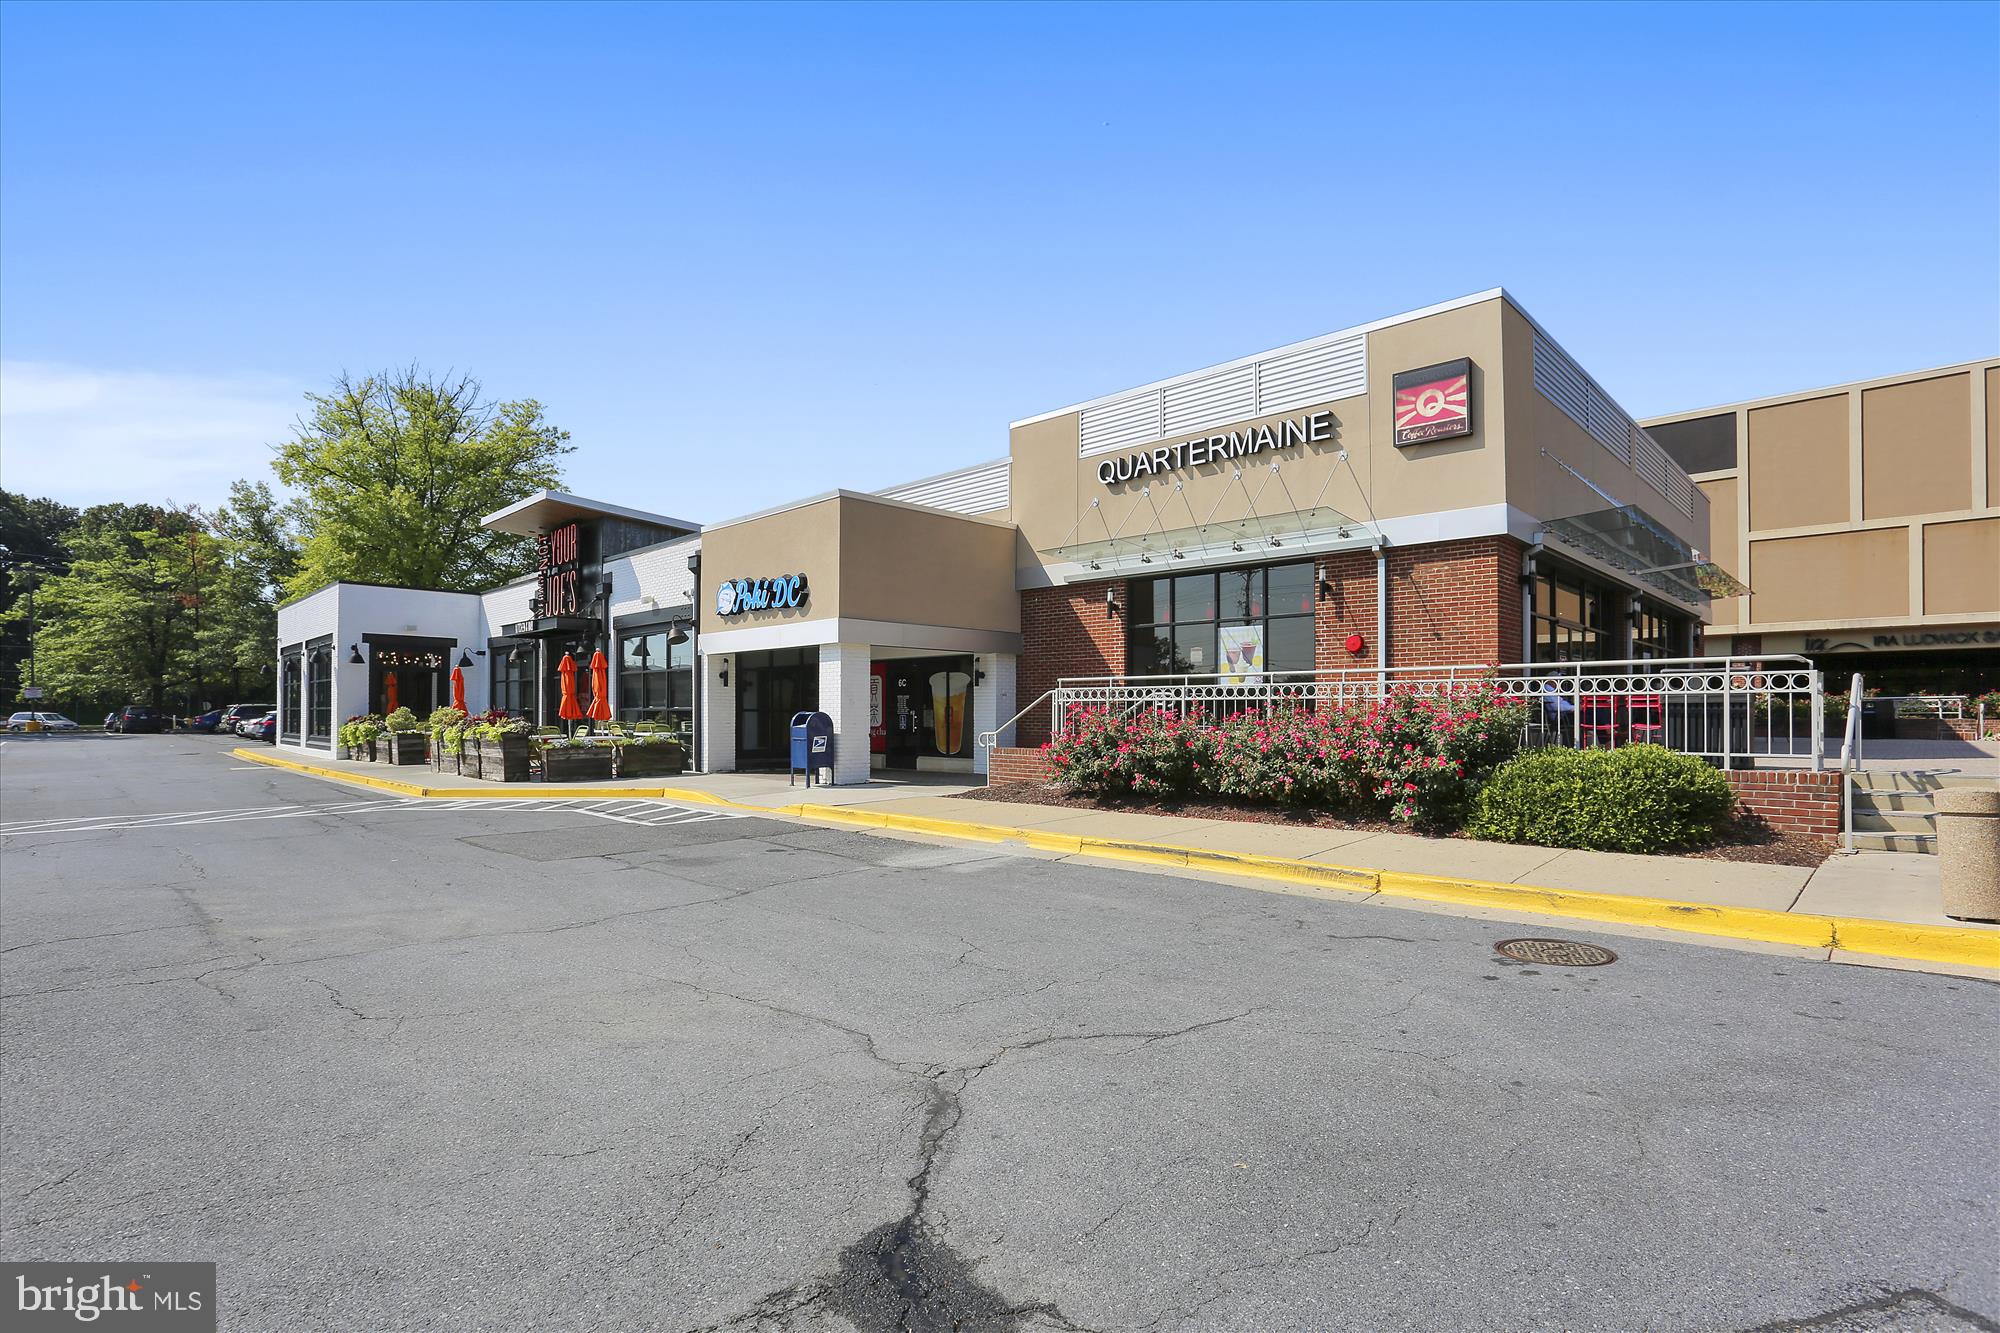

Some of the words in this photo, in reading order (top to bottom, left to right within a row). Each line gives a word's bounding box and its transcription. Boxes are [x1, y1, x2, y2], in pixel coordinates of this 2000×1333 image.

[1097, 410, 1332, 484] QUARTERMAINE
[1402, 428, 1425, 440] Coffee
[538, 534, 549, 571] NOT
[551, 523, 577, 567] YOUR
[545, 570, 576, 618] JOE'S
[733, 579, 770, 612] Poki
[771, 575, 801, 607] DC
[1873, 634, 1899, 647] IRA
